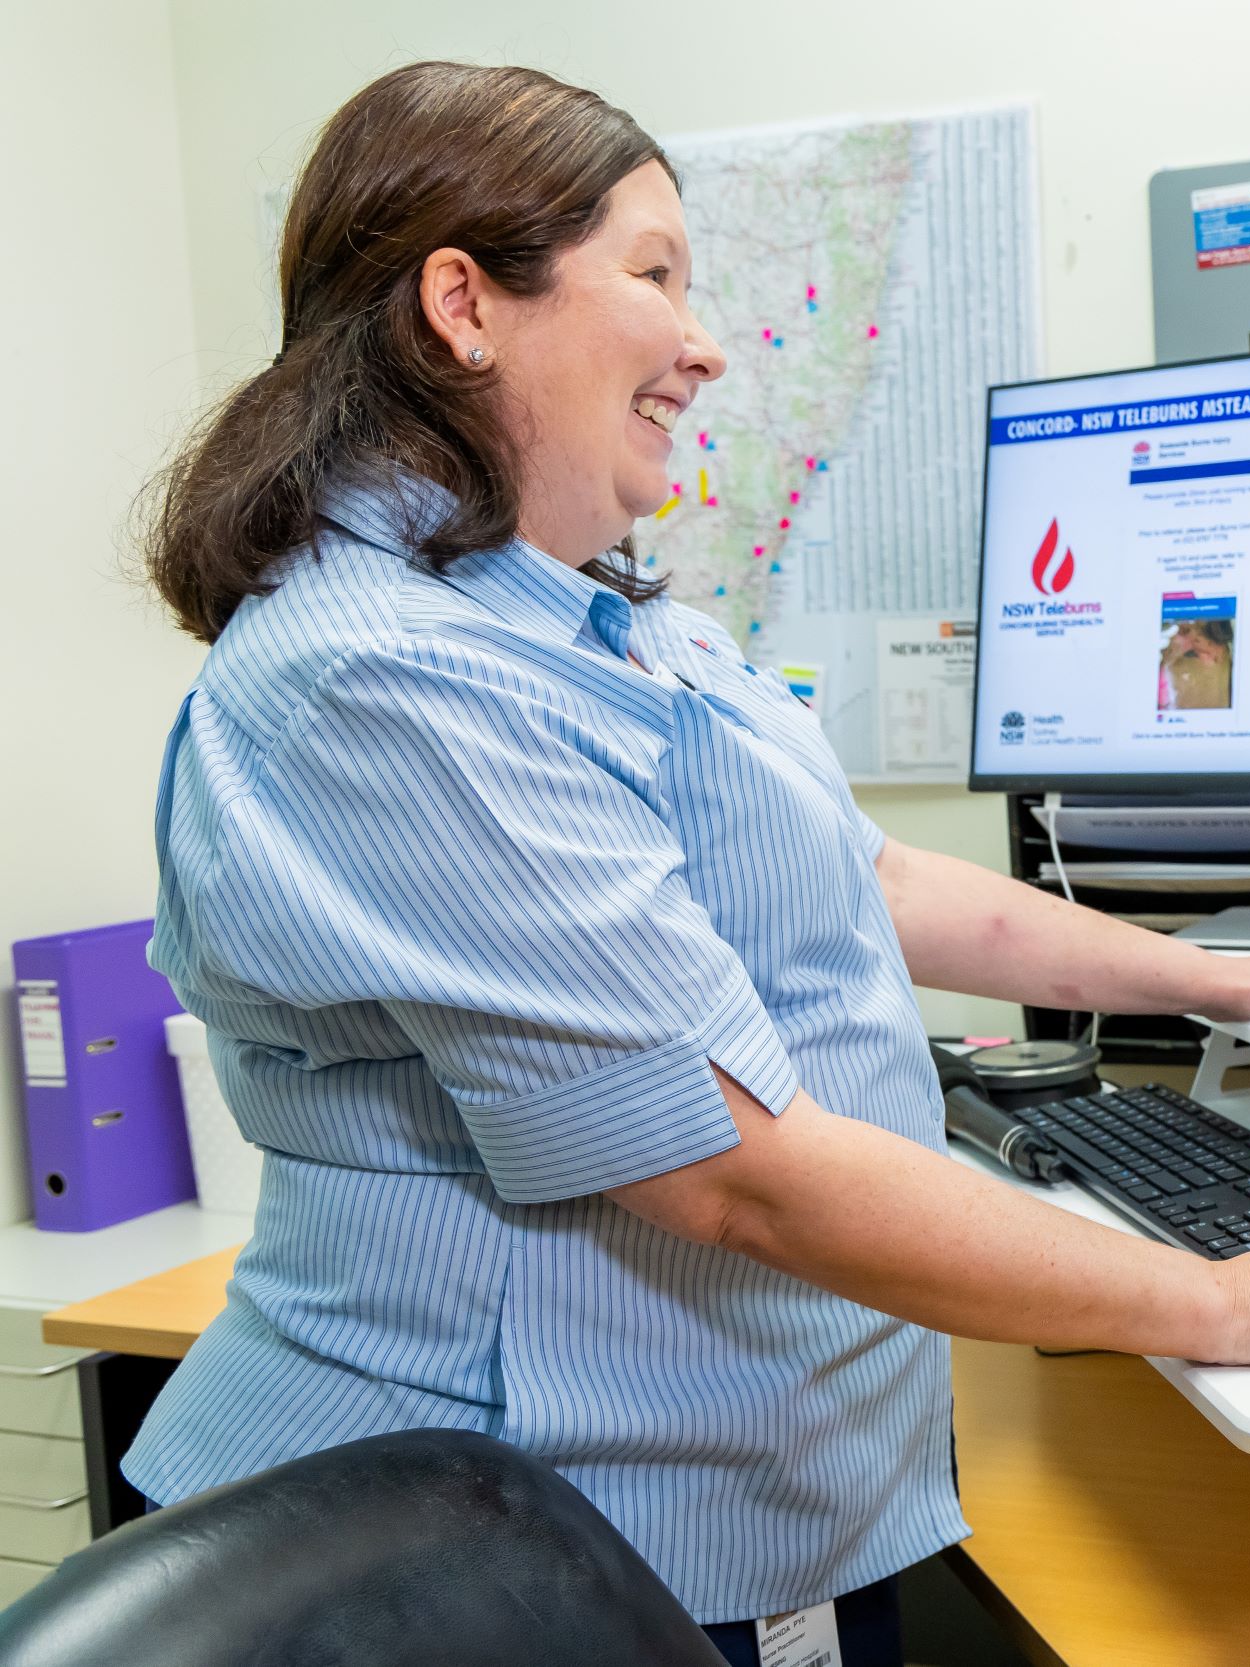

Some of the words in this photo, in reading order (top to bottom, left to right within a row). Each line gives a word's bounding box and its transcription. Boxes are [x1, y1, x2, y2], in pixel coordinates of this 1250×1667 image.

[1007, 415, 1078, 440] CONCORD-
[1081, 410, 1114, 431] NSW
[1117, 400, 1198, 427] TELEBURNS
[1002, 603, 1035, 618] NSW
[1038, 602, 1102, 616] Teleburns
[1034, 620, 1058, 628] BURNS
[1060, 618, 1104, 627] TELEHEALTH
[889, 642, 922, 656] NEW
[1034, 714, 1064, 725] Health
[1000, 731, 1025, 742] NSW
[761, 1626, 791, 1648] MIRANDA
[793, 1615, 807, 1628] PYE
